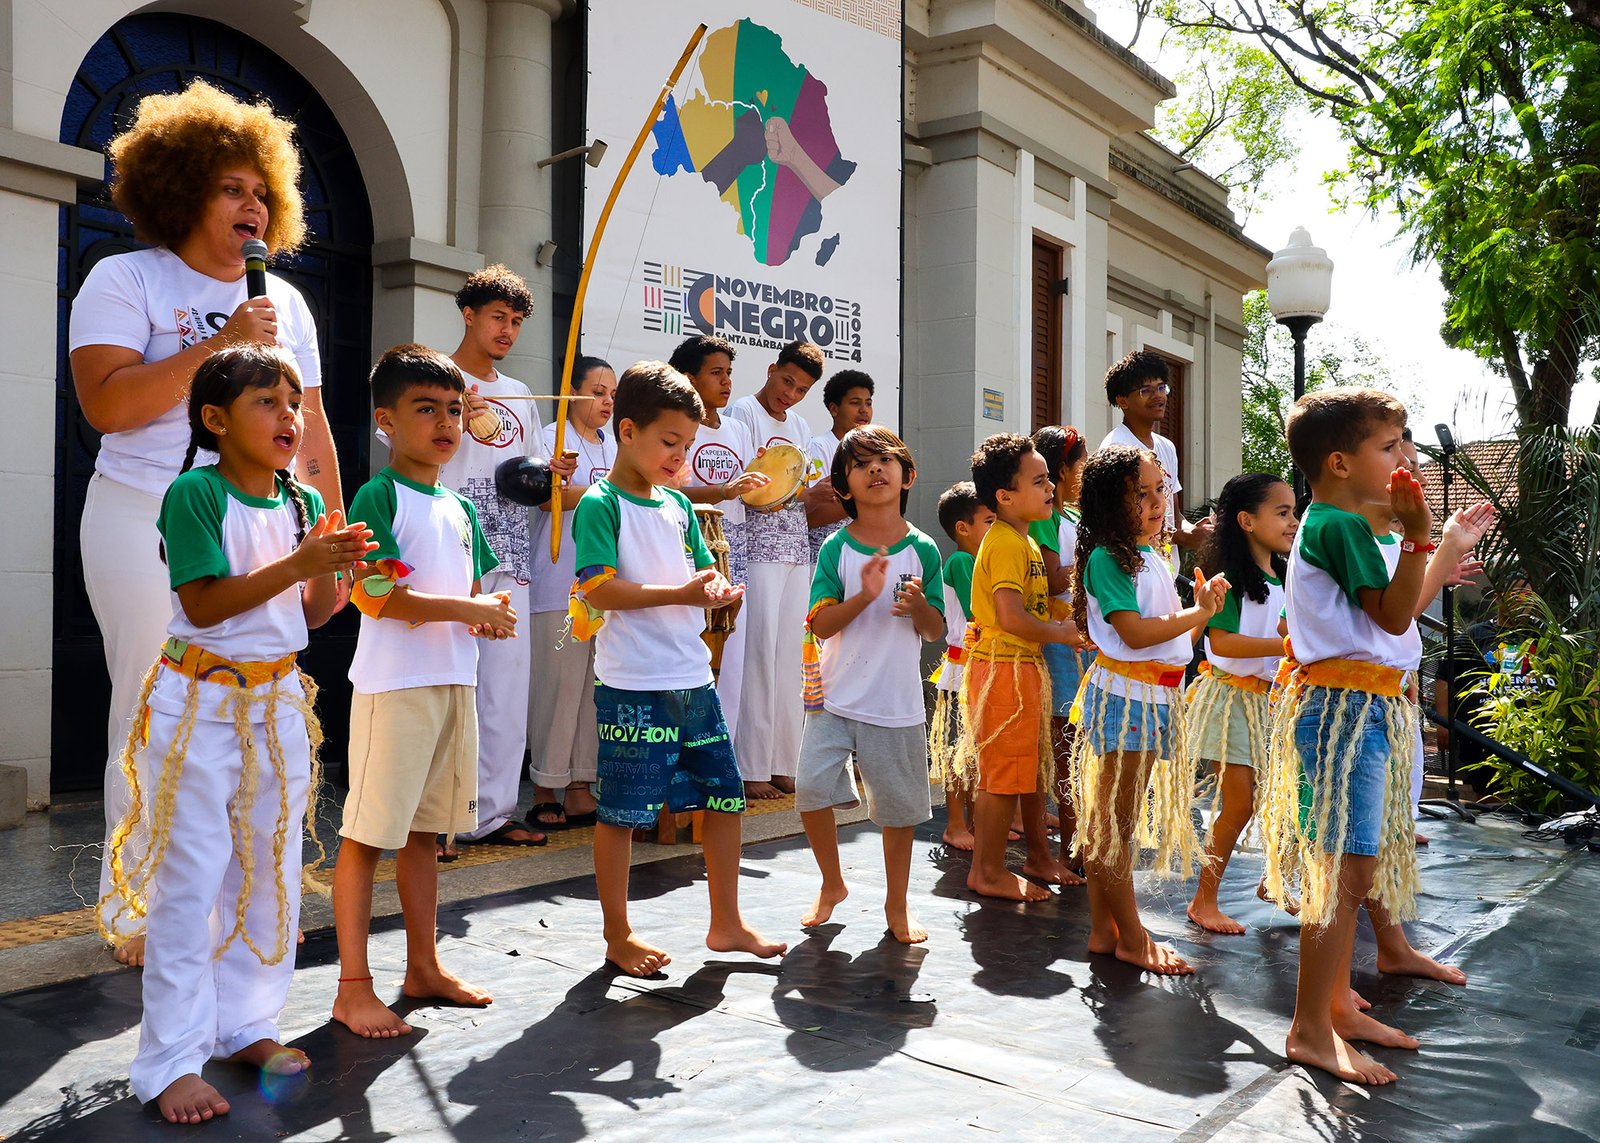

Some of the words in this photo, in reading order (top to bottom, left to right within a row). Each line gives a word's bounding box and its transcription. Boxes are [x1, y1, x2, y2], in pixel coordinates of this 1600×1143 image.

[716, 275, 834, 314] NOVEMBRO
[715, 297, 835, 346] NEGRO
[715, 332, 748, 346] SANTA
[851, 302, 862, 363] 2024
[698, 455, 733, 469] Império
